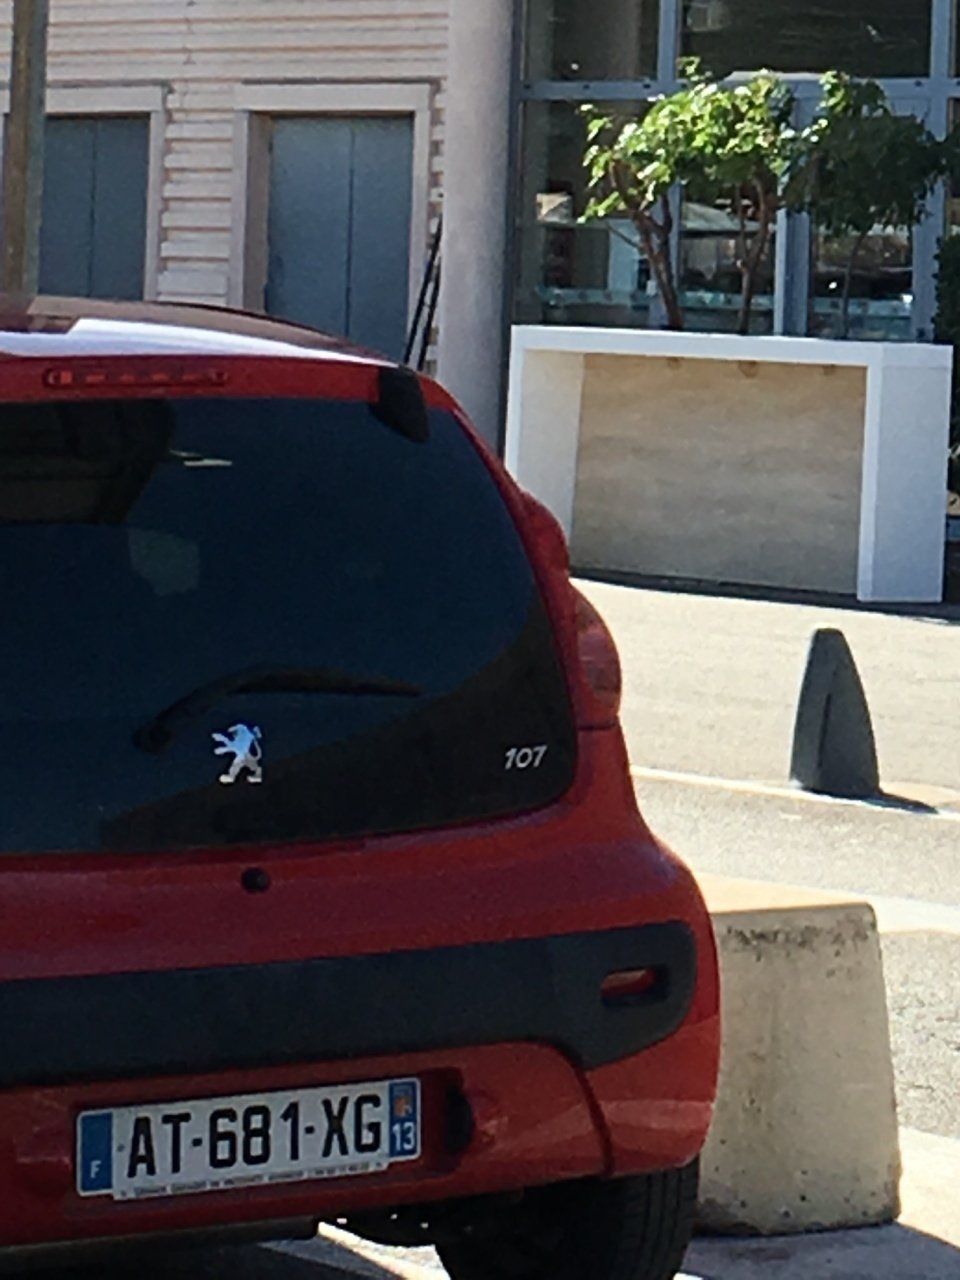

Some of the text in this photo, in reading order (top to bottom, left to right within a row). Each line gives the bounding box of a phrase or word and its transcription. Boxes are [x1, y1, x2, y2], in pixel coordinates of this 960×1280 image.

[504, 744, 548, 770] 107
[126, 1094, 382, 1179] AT-681-XG
[391, 1121, 416, 1152] 13
[90, 1159, 102, 1179] F
